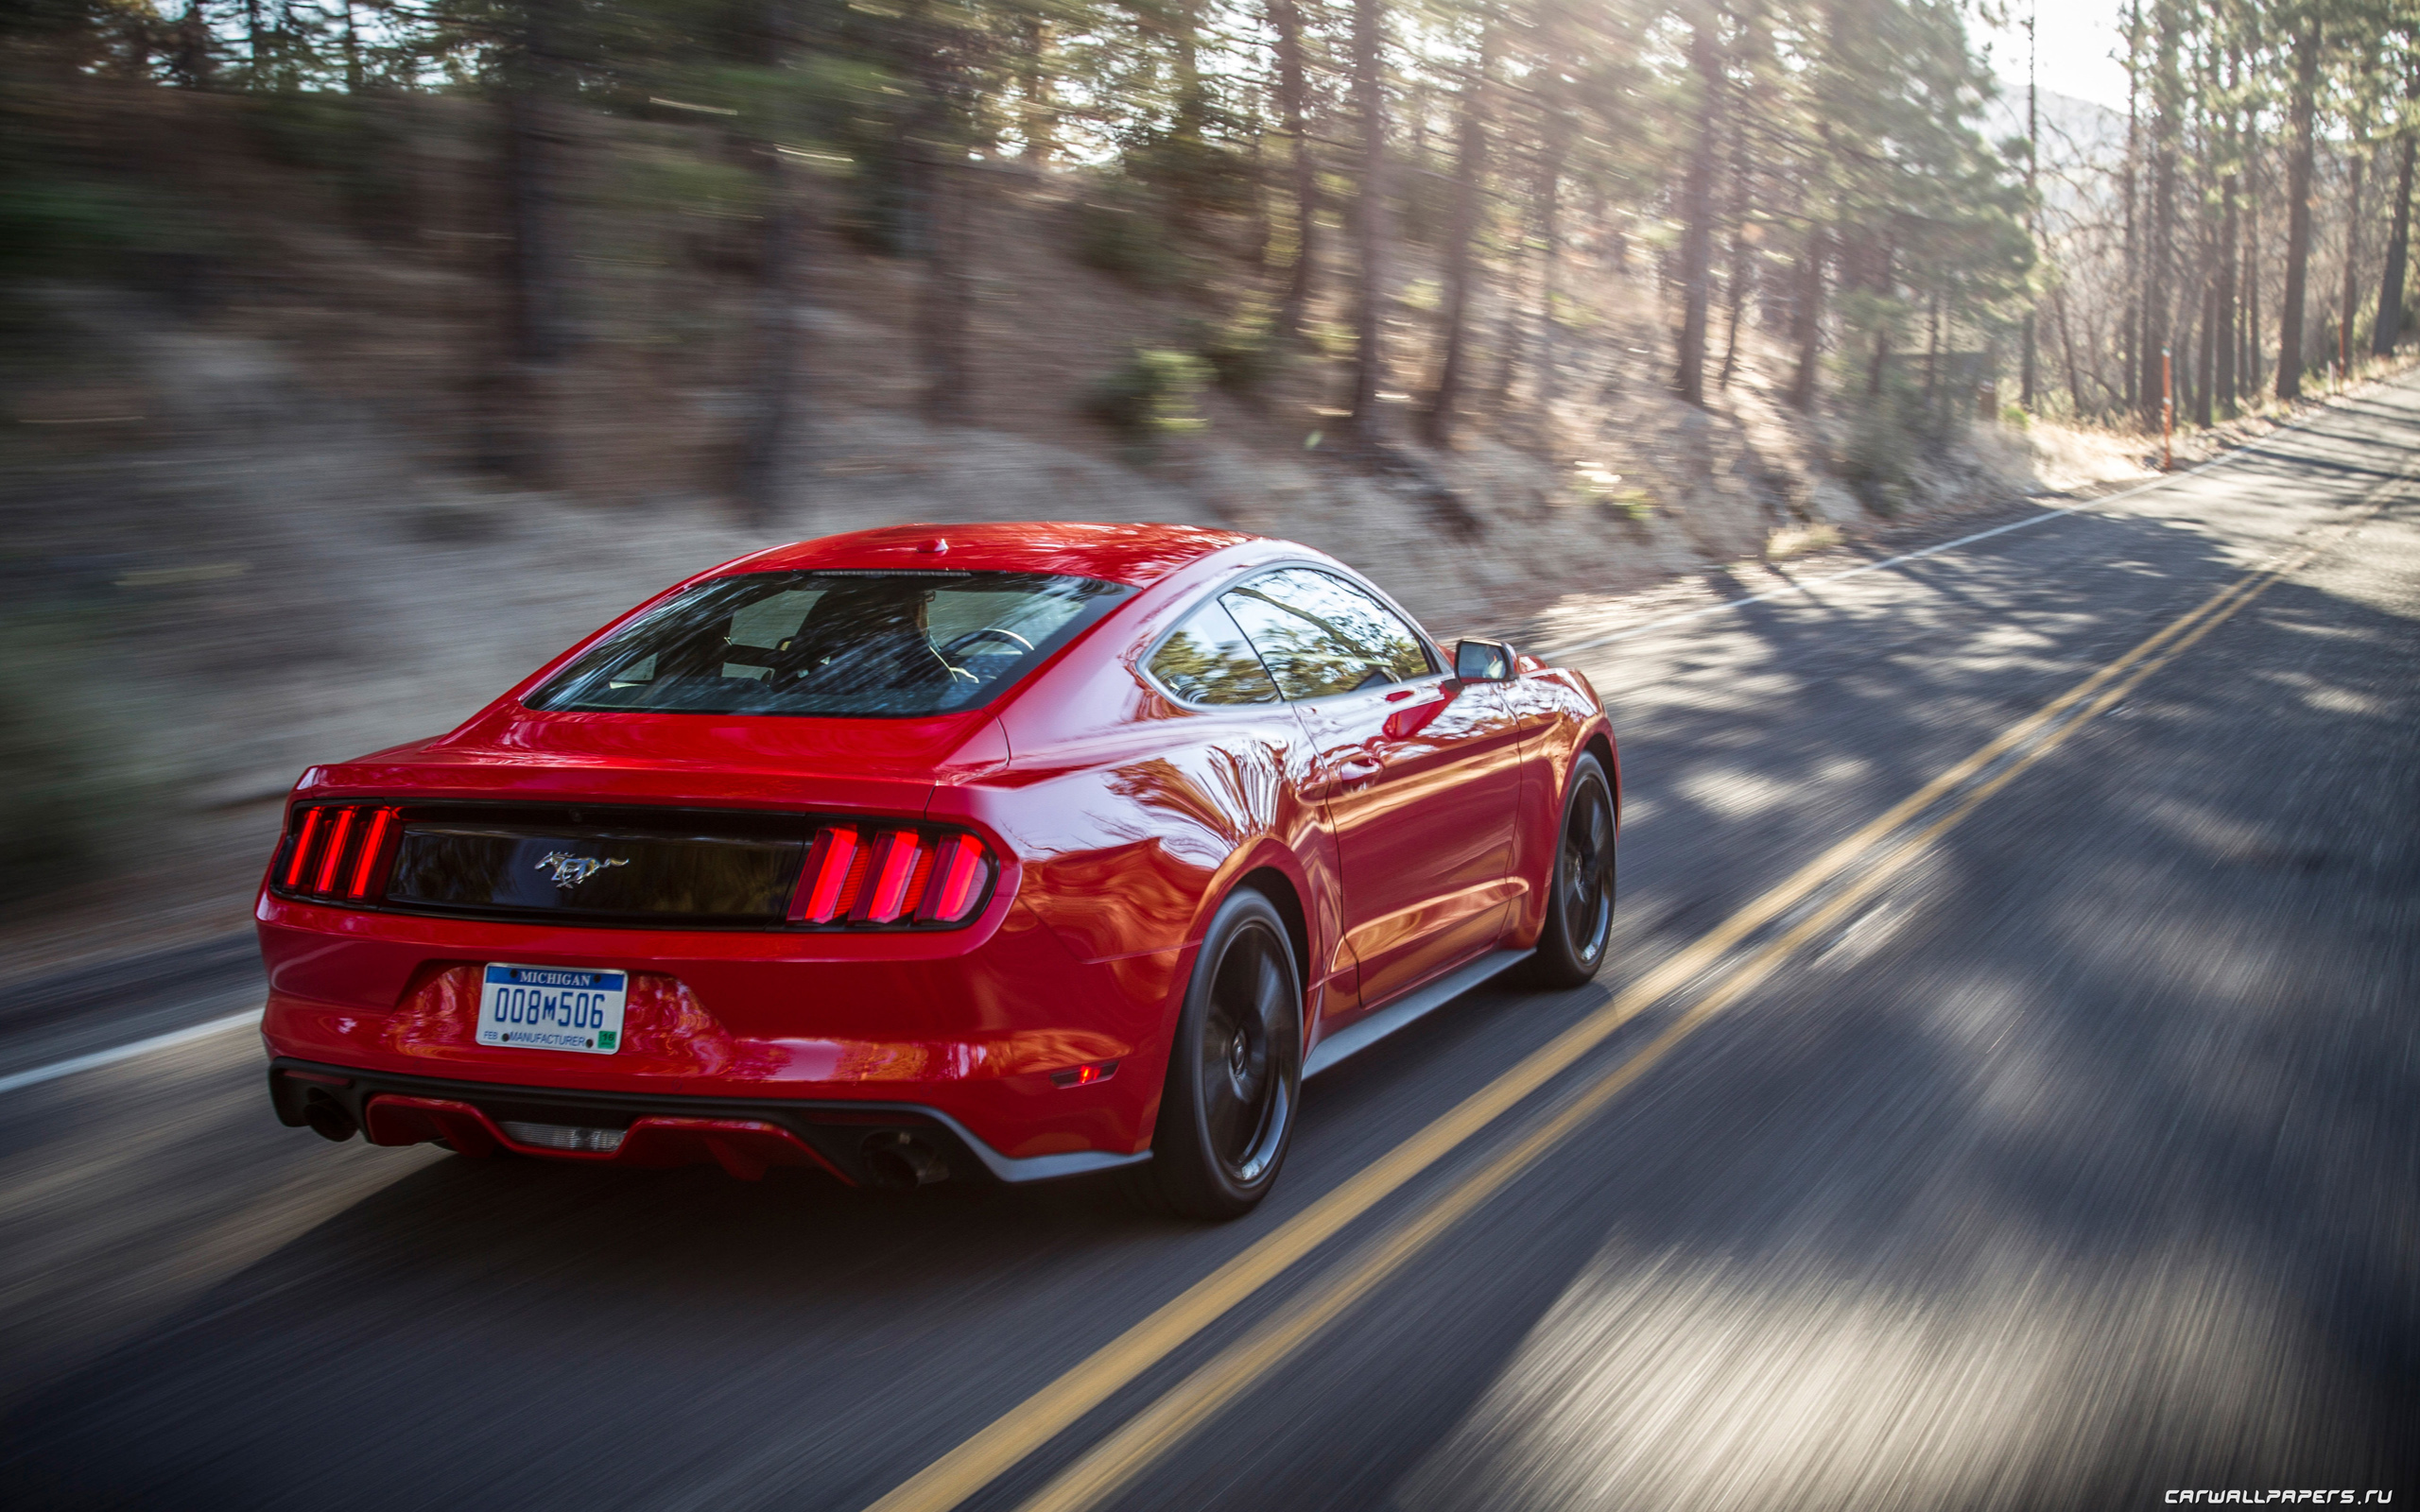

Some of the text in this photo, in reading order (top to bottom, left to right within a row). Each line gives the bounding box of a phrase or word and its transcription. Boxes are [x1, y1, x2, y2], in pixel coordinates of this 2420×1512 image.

[520, 971, 591, 987] MICHIGAN
[494, 988, 605, 1029] 008M506
[483, 1031, 498, 1040] FEB
[509, 1031, 586, 1047] MANUFACTURER
[602, 1033, 614, 1041] 16
